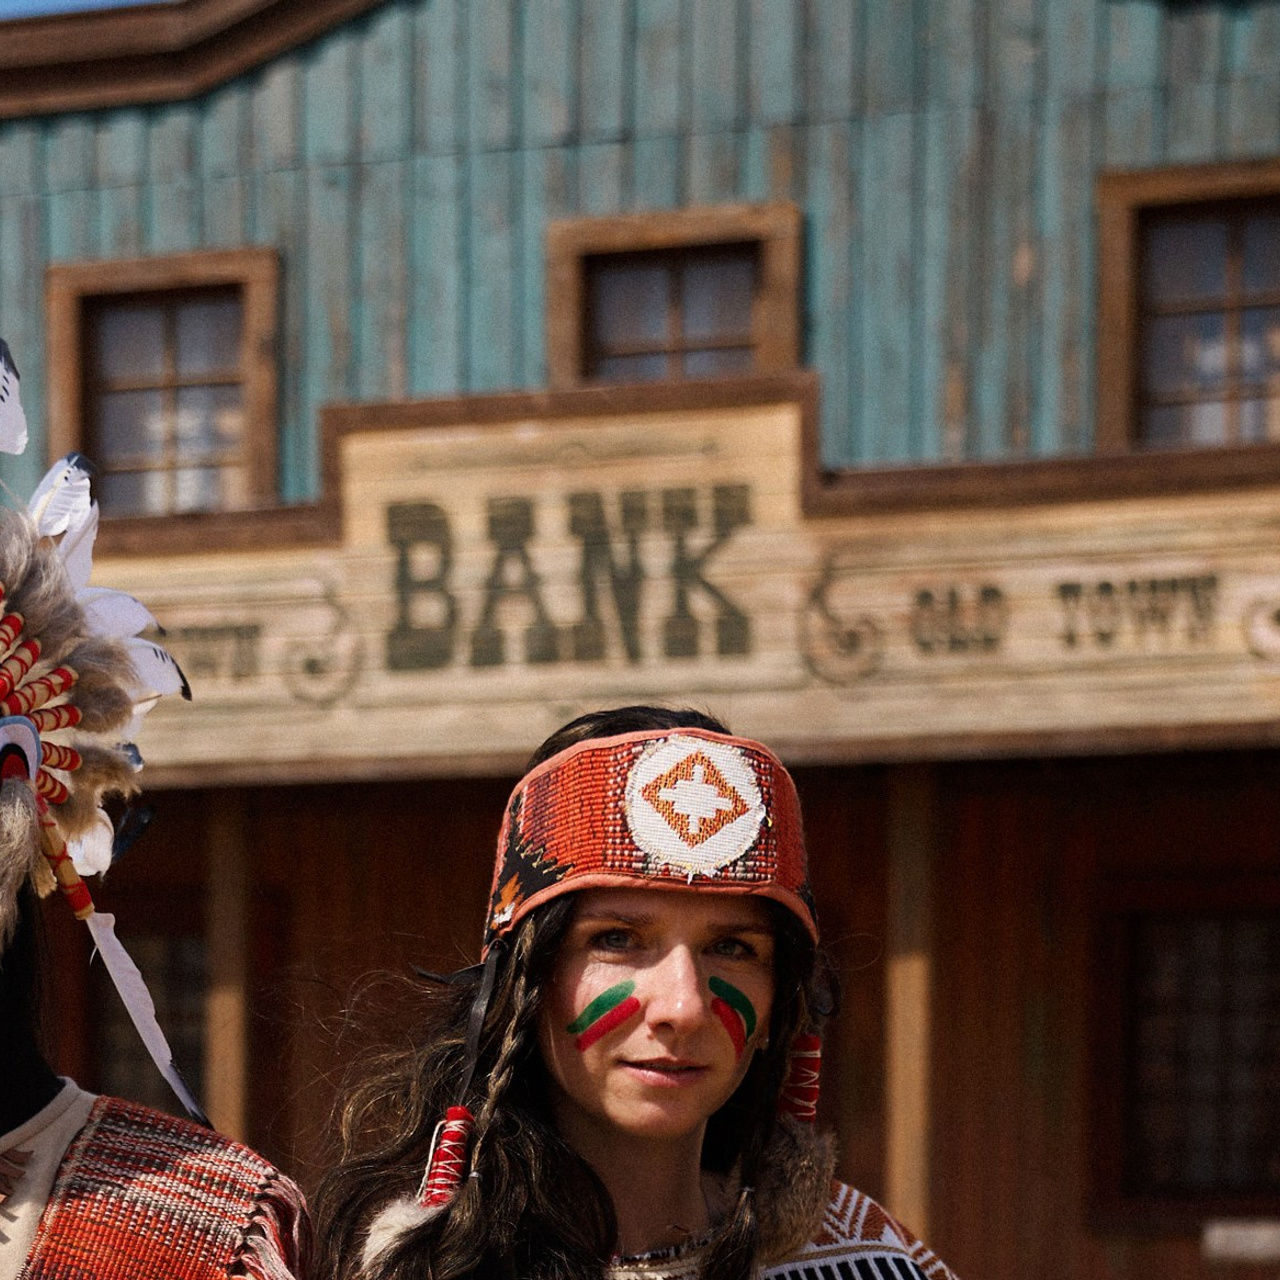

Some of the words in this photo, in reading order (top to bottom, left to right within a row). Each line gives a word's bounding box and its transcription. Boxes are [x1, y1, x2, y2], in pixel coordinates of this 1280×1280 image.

[384, 484, 752, 670] BANK
[911, 585, 1006, 653] OLD
[1057, 574, 1217, 649] TOWN
